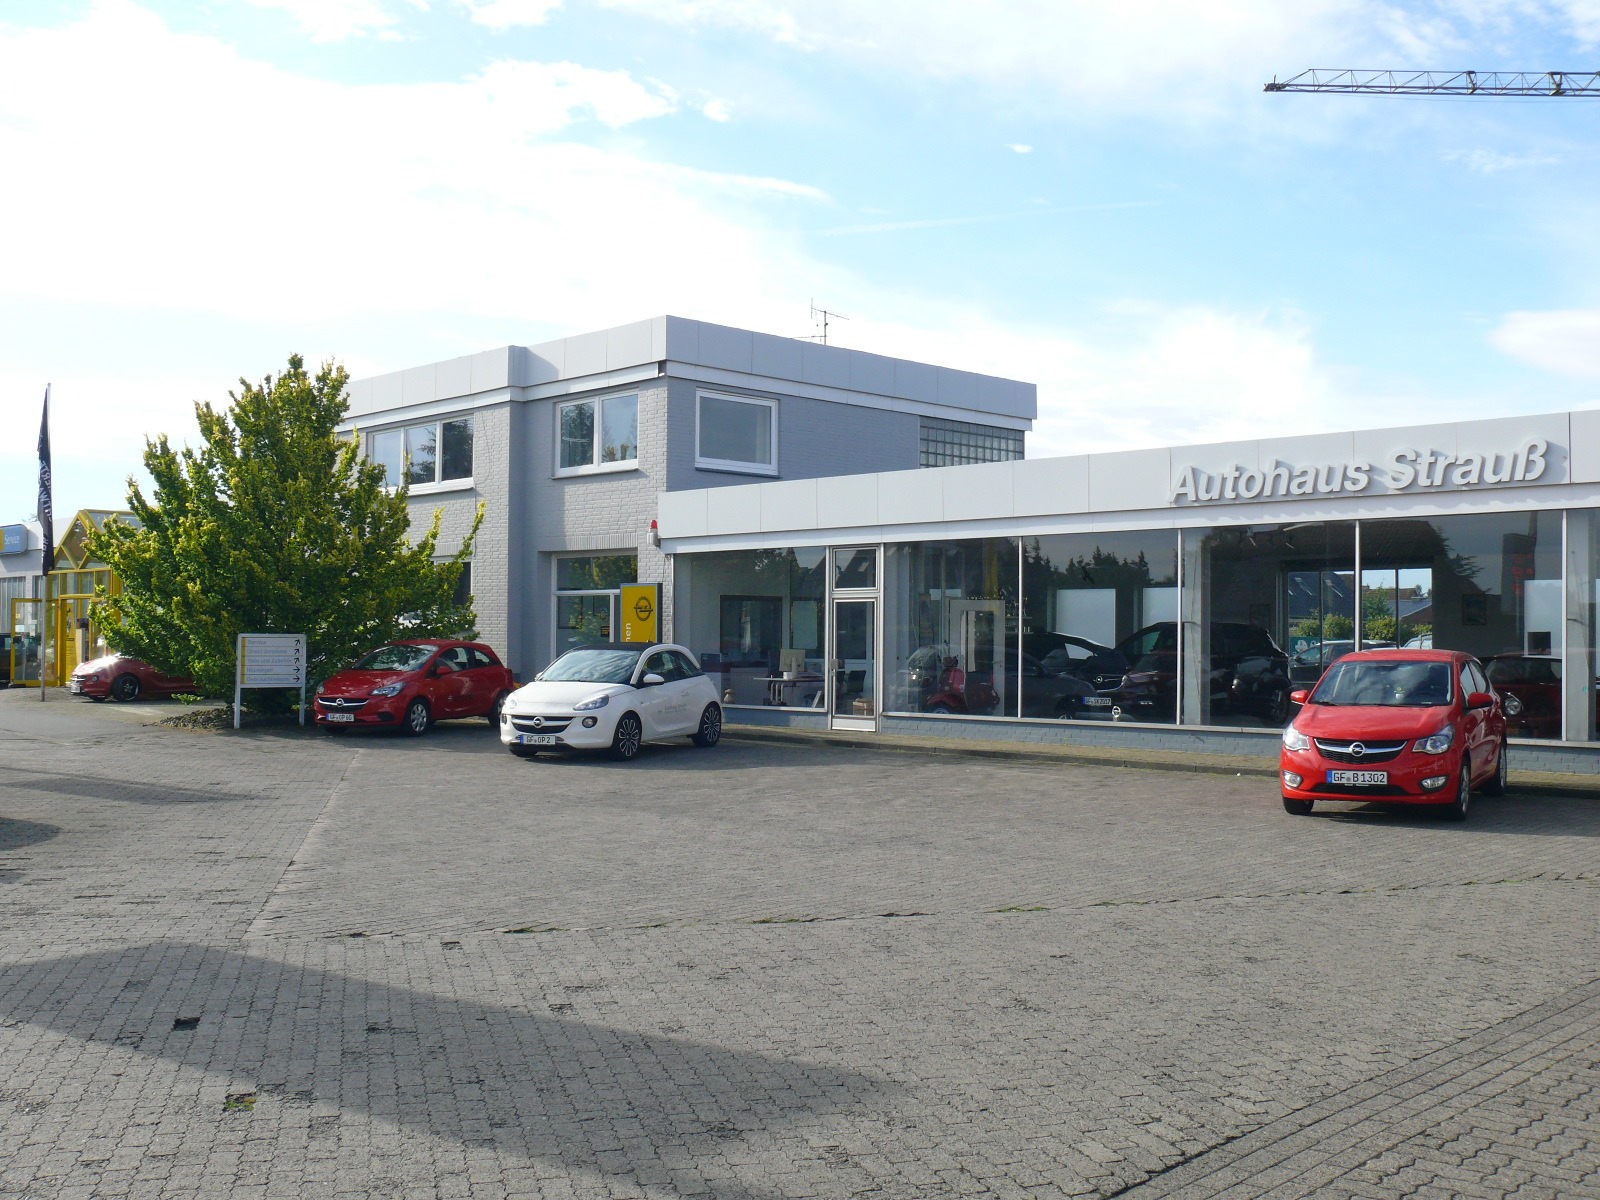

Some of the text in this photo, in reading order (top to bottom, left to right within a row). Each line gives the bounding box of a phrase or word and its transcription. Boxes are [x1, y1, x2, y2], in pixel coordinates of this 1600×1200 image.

[1169, 438, 1547, 504] Autohaus Strauß
[1333, 772, 1346, 782] GF
